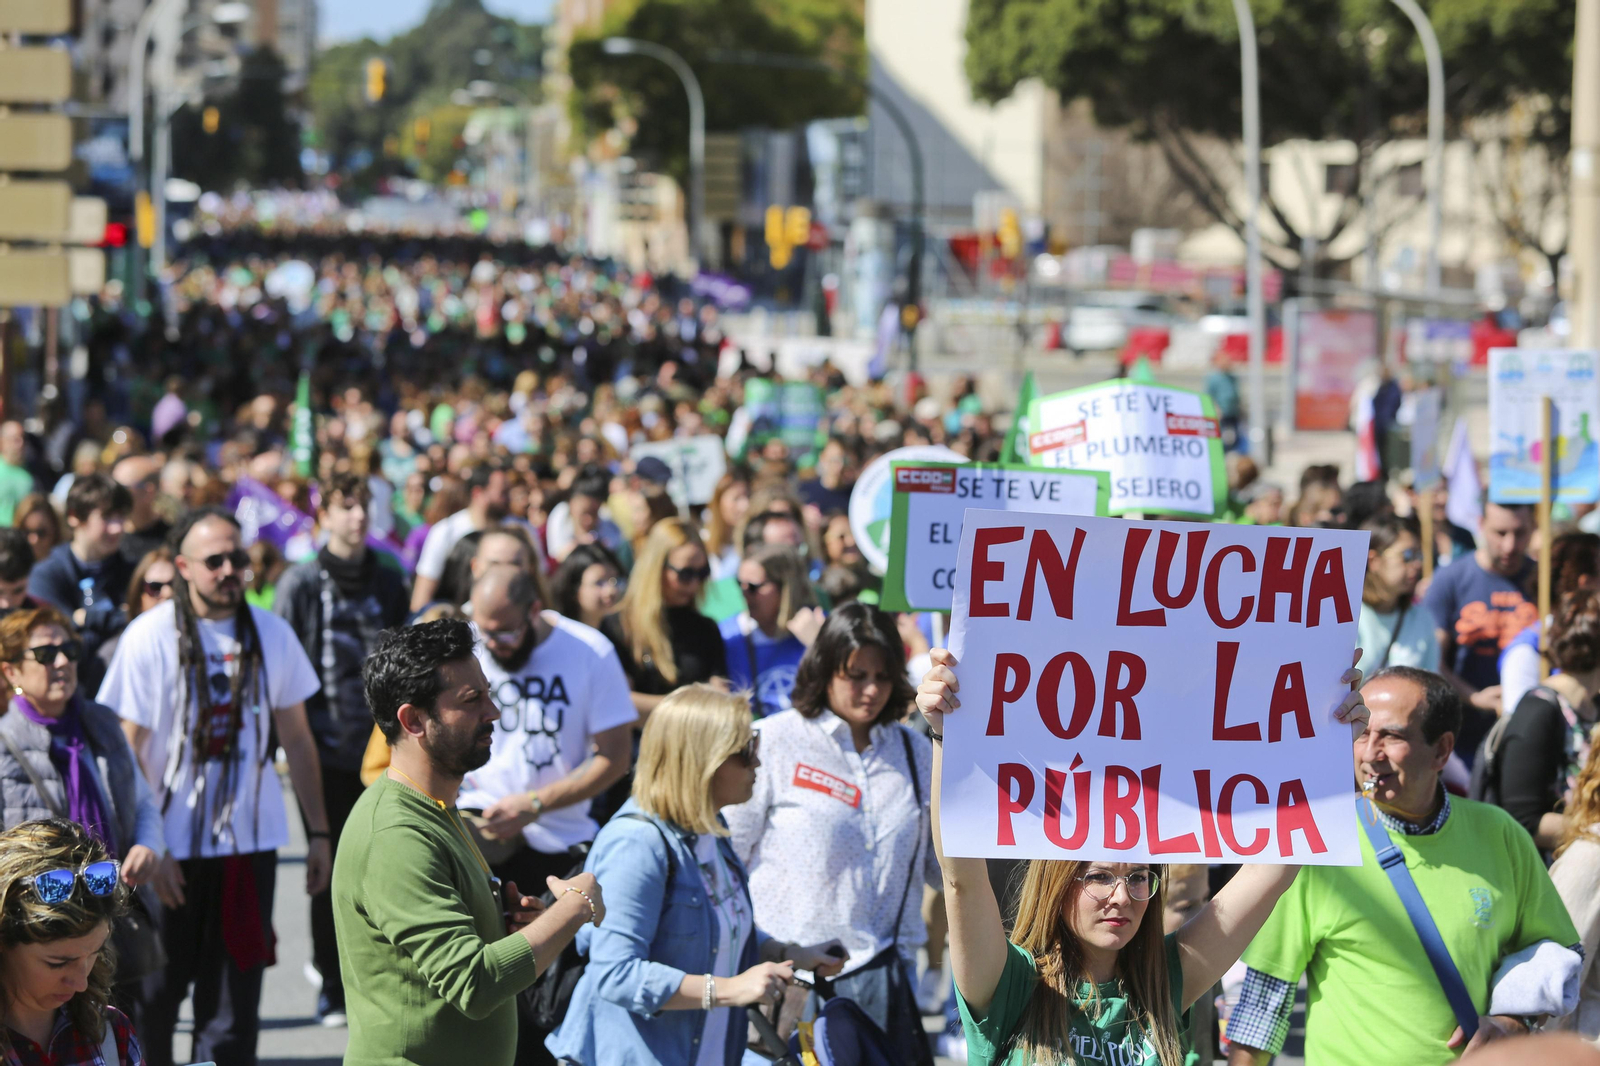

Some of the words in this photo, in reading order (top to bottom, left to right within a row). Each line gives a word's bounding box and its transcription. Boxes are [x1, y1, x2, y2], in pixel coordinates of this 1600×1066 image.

[1077, 400, 1102, 419] SE
[1111, 392, 1139, 412] TE
[1145, 394, 1174, 414] VE
[1054, 450, 1079, 469] EL
[1086, 436, 1203, 462] PLUMERO
[957, 477, 984, 499] SE
[992, 478, 1020, 500] TE
[1030, 480, 1061, 502] VE
[929, 522, 953, 544] EL
[968, 525, 1087, 622] EN
[1116, 527, 1354, 629] LUCHA
[985, 650, 1147, 740] POR
[1212, 641, 1316, 743] LA
[996, 752, 1328, 858] PÚBLICA
